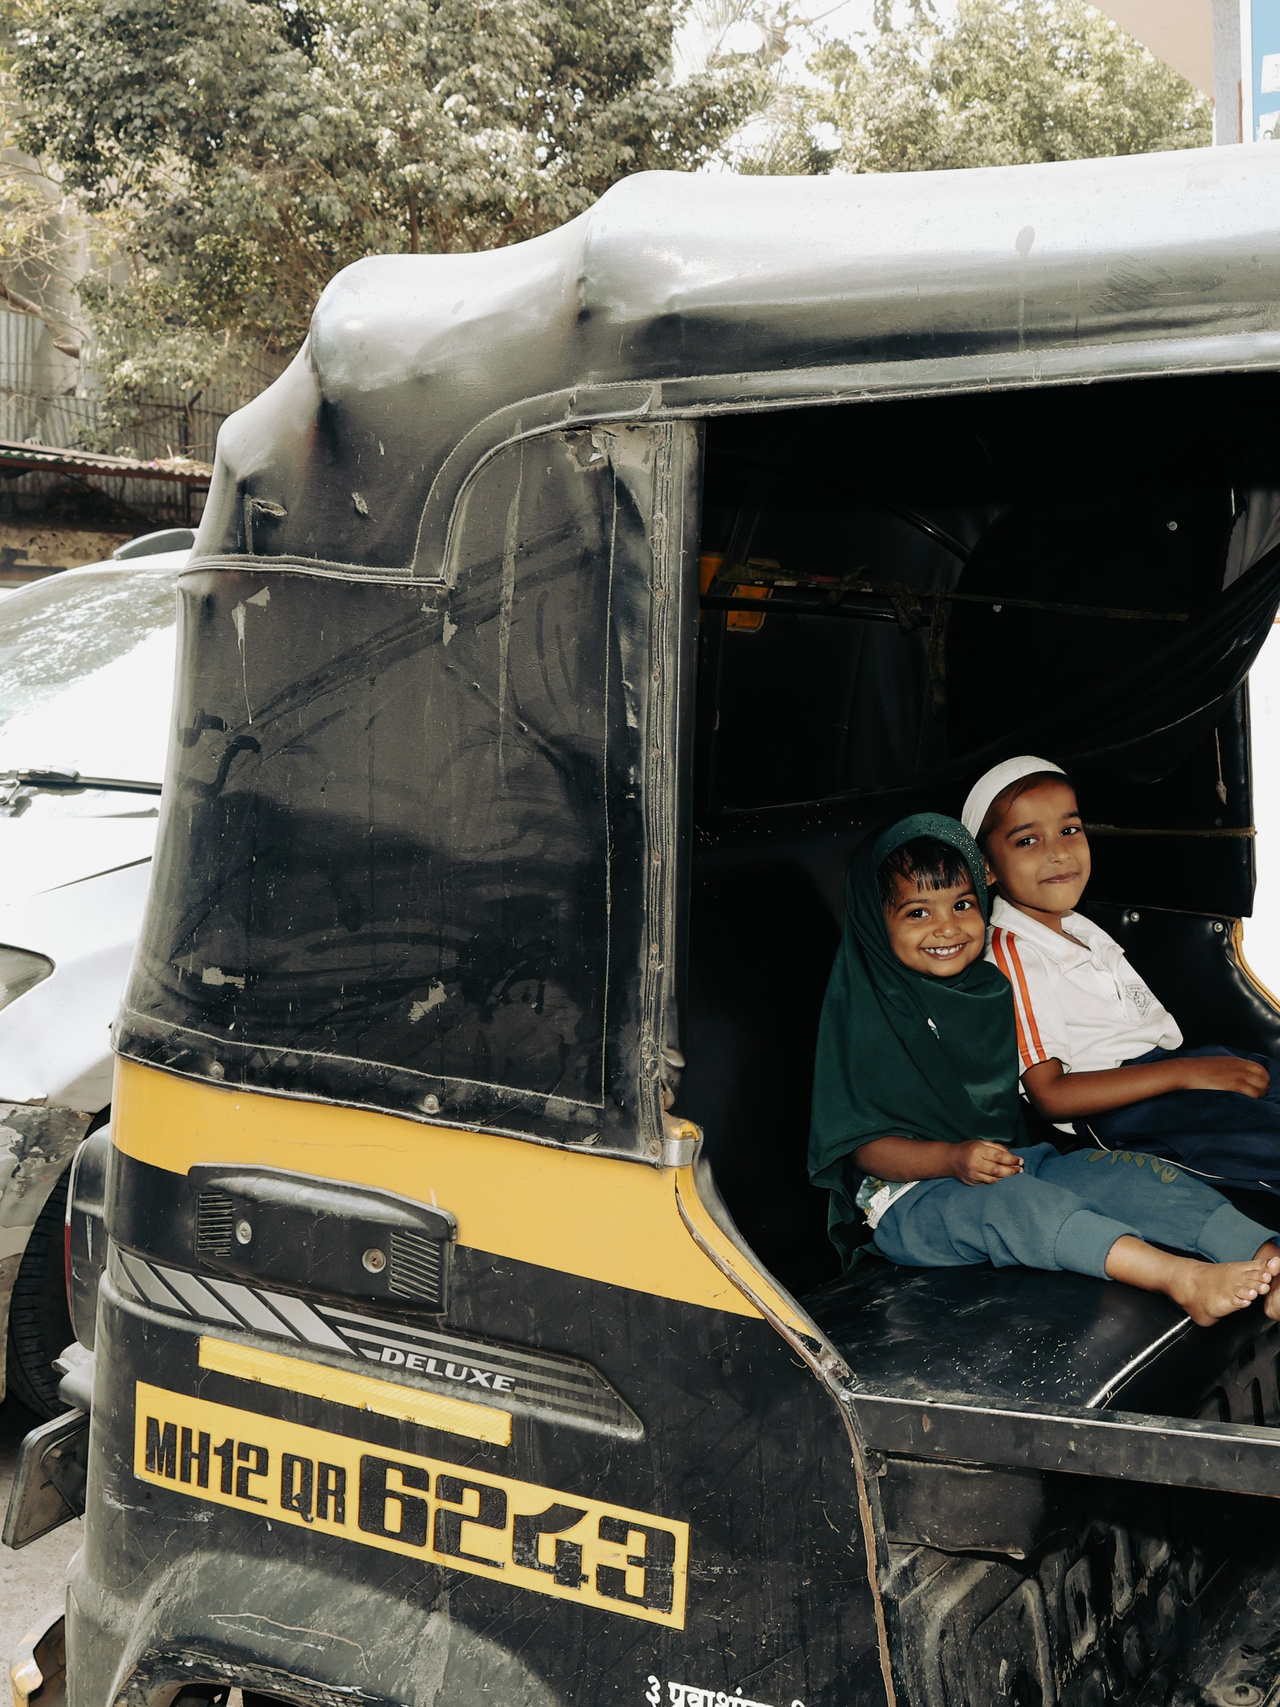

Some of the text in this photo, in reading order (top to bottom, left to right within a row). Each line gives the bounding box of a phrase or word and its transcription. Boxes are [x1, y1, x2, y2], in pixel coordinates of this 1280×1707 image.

[380, 1347, 515, 1393] DELUXE
[145, 1416, 676, 1615] MH12 QR 6243
